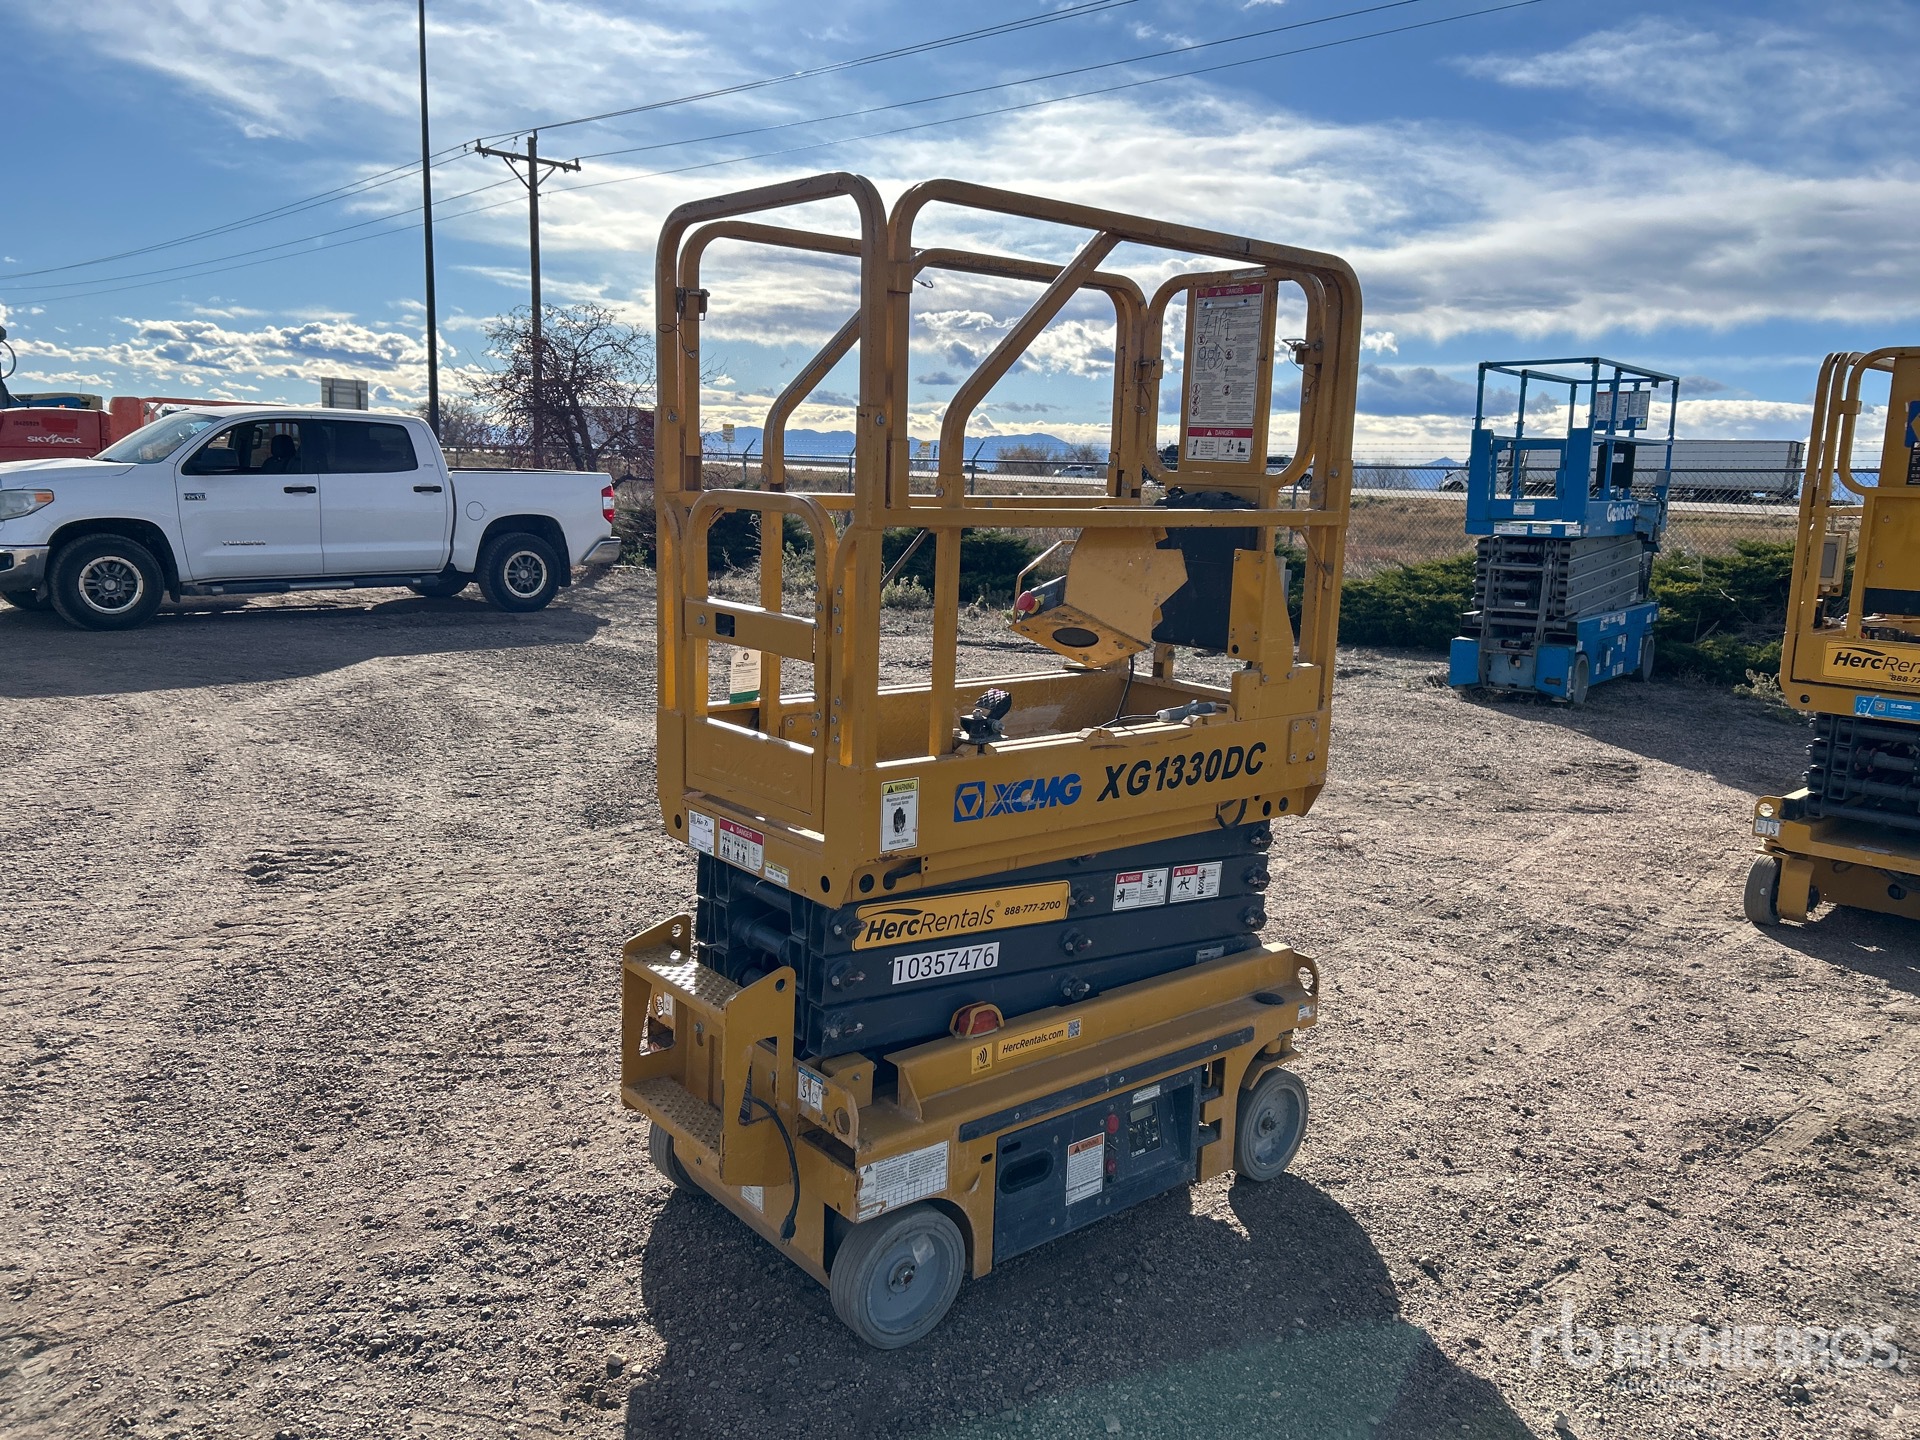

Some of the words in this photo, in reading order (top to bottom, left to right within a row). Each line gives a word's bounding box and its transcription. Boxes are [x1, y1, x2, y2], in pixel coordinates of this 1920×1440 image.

[27, 433, 82, 444] SKYJACK
[1606, 503, 1625, 522] Genie
[1097, 742, 1267, 802] XG1330DC
[894, 782, 914, 792] WARNING
[985, 773, 1082, 817] XCMG
[736, 827, 753, 840] DANGER
[1125, 874, 1141, 882] DANGER
[1182, 867, 1196, 875] DANGER
[1004, 900, 1061, 916] 888-777-2700
[896, 946, 995, 982] 10357476
[1002, 1029, 1064, 1054] HercRentals.com
